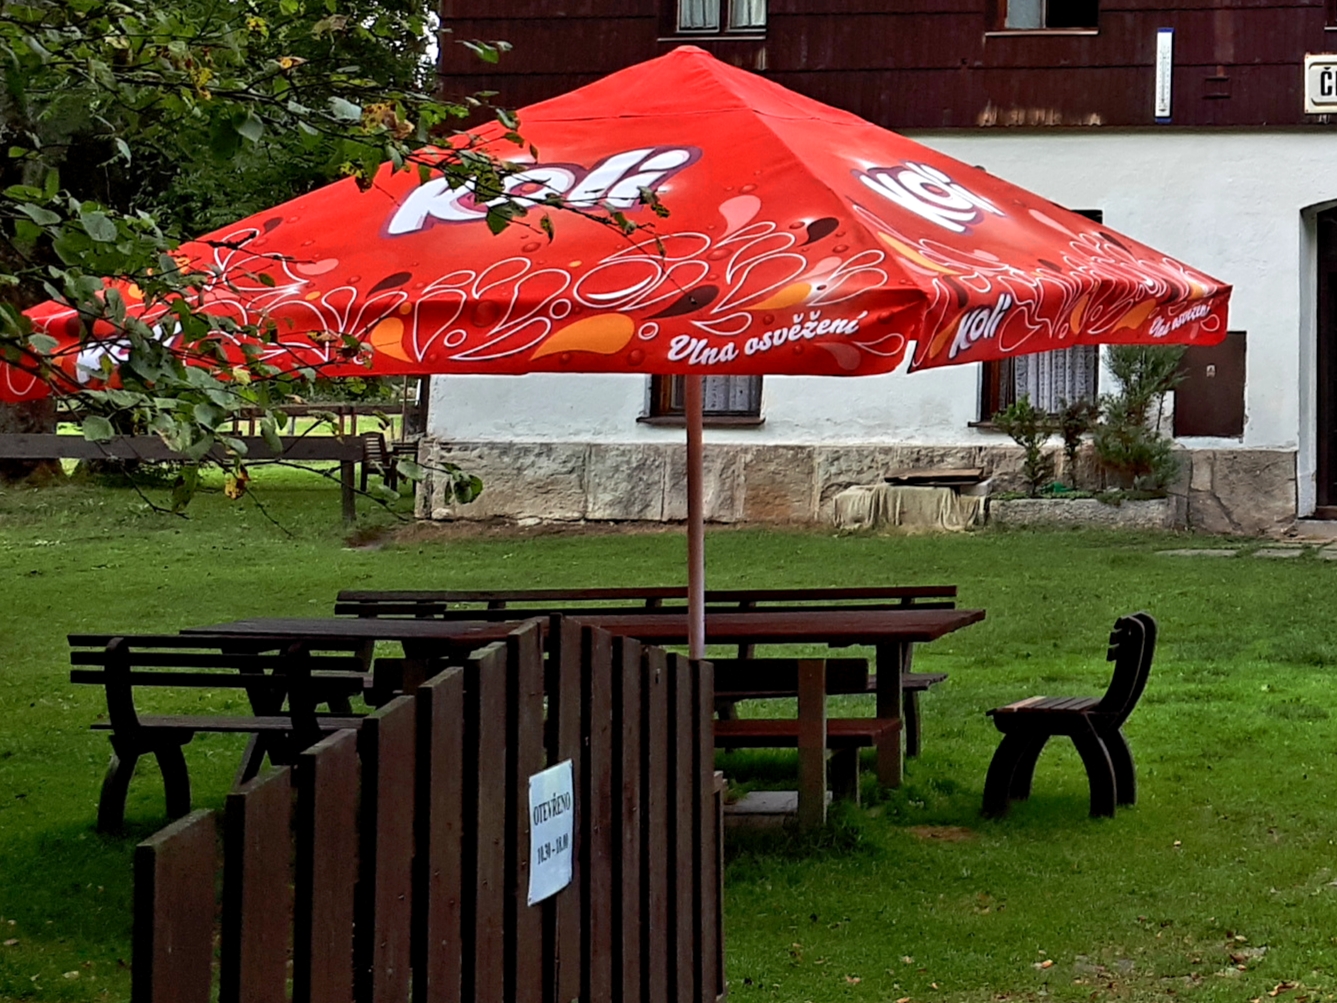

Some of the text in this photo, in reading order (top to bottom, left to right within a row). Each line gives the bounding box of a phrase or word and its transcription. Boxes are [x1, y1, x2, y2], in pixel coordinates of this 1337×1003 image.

[667, 310, 869, 366] Vlna osvěžení
[533, 792, 570, 825] OTEVŘENO
